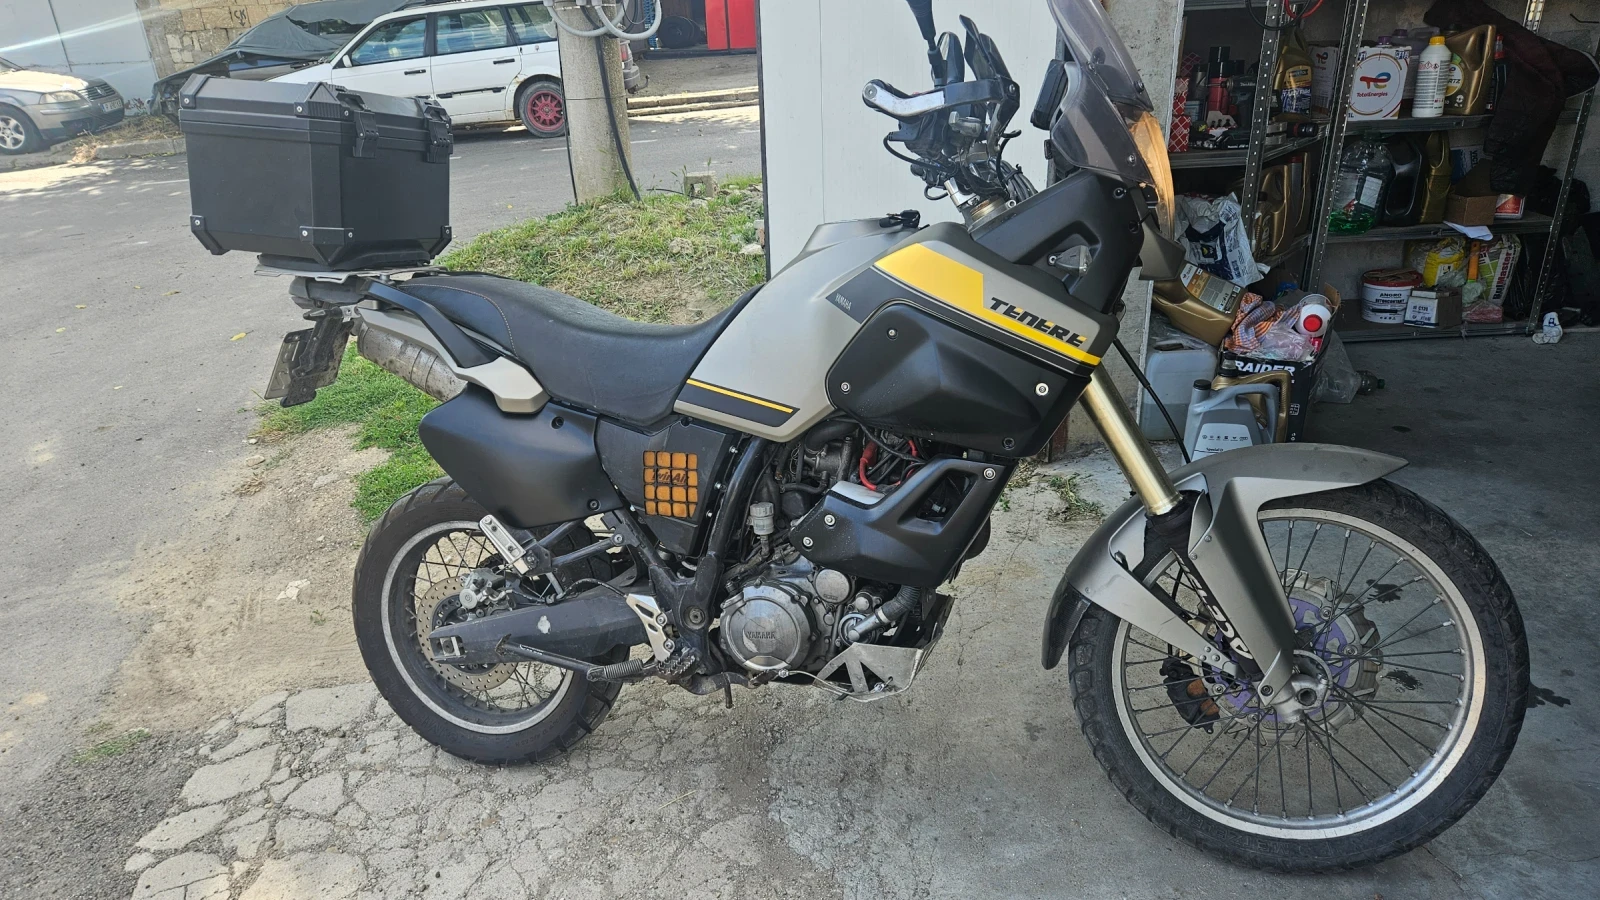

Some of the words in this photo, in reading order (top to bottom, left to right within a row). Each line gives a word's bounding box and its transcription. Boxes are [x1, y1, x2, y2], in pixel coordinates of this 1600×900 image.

[1492, 252, 1512, 300] BulMaster
[835, 292, 852, 311] YAMAHA
[990, 296, 1088, 348] TENERE
[1234, 360, 1296, 376] RAIDER
[746, 631, 776, 640] YAMAHA
